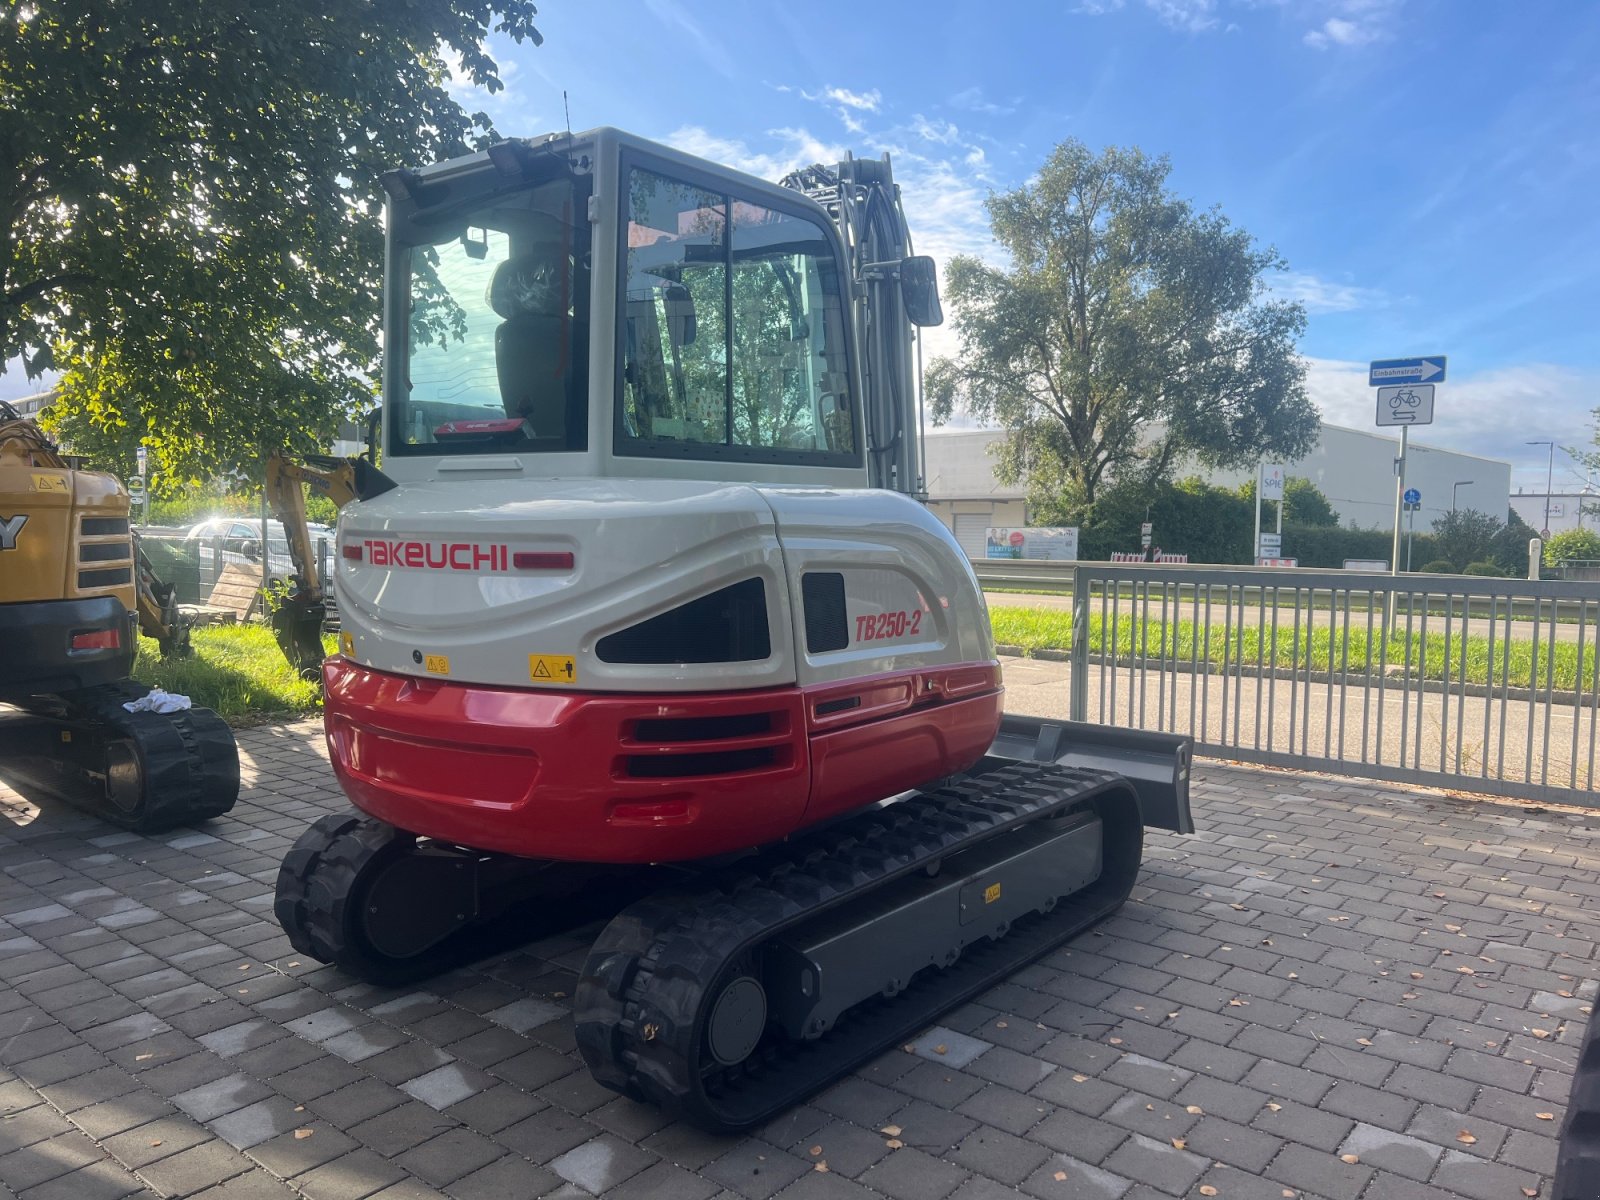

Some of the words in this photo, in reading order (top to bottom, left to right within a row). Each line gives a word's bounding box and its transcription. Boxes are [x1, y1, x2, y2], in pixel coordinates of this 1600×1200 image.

[1373, 367, 1423, 377] Einbahnstraße
[1264, 478, 1282, 489] SPIE
[855, 609, 922, 642] TB250-2
